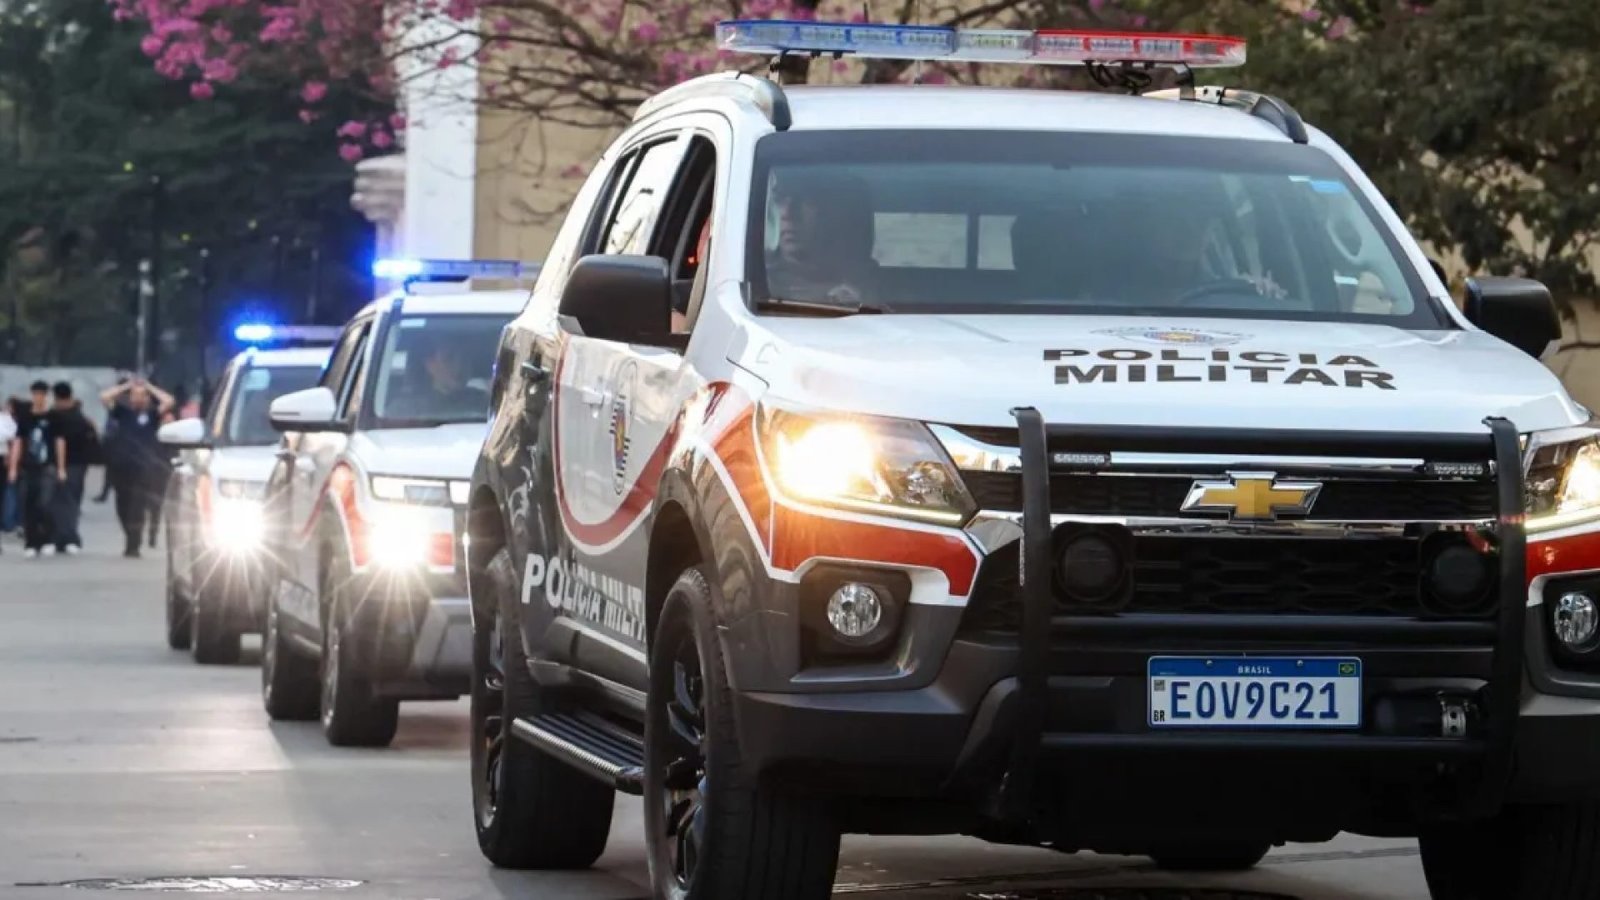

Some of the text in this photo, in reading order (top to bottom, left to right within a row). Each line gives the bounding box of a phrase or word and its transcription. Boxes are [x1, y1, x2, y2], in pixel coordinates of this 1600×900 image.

[1054, 365, 1397, 390] MILITAR
[603, 574, 646, 643] MILIT
[1238, 666, 1271, 674] BRASIL
[1171, 681, 1339, 719] EOV9C21
[1153, 710, 1165, 721] BR
